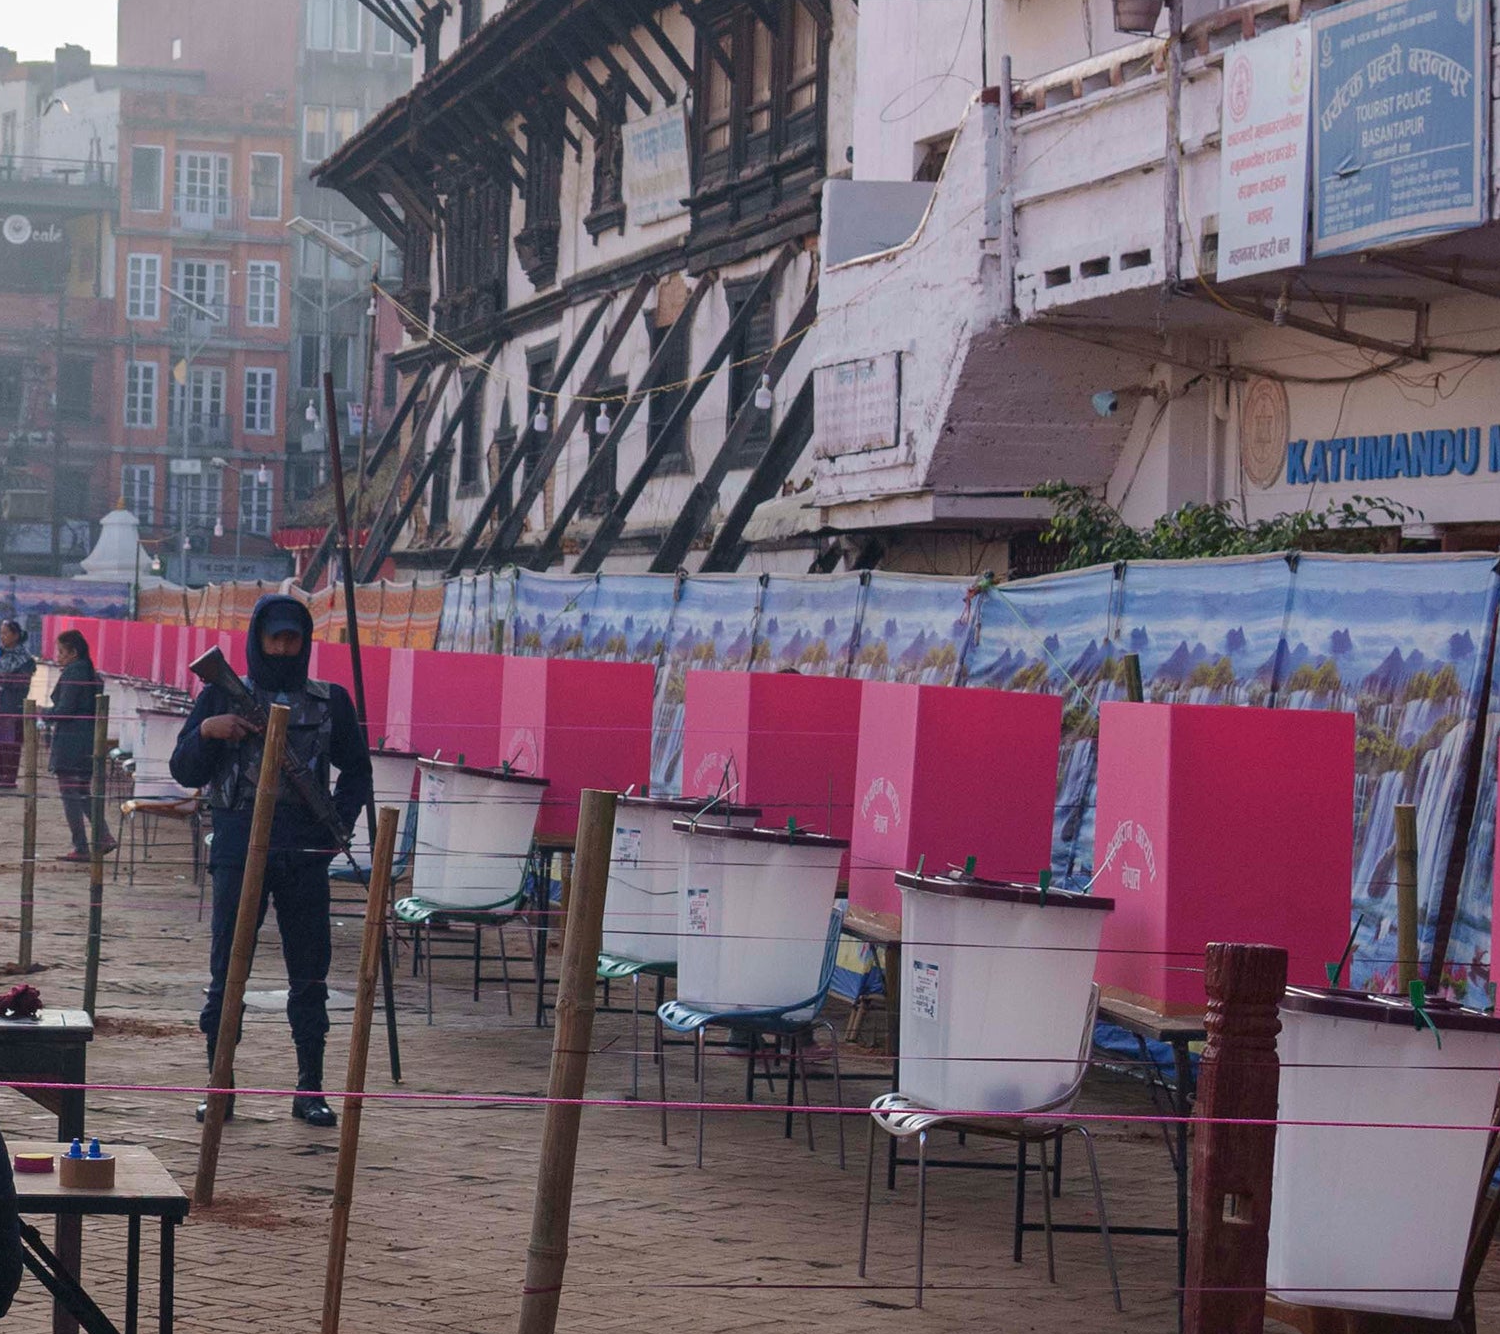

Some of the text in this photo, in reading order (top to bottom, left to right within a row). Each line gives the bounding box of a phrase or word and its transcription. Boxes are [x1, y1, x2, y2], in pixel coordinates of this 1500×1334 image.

[1355, 86, 1433, 124] TOURIST POLICE
[1361, 116, 1425, 148] BASANTAPUR
[1286, 425, 1481, 486] KATHMANDU
